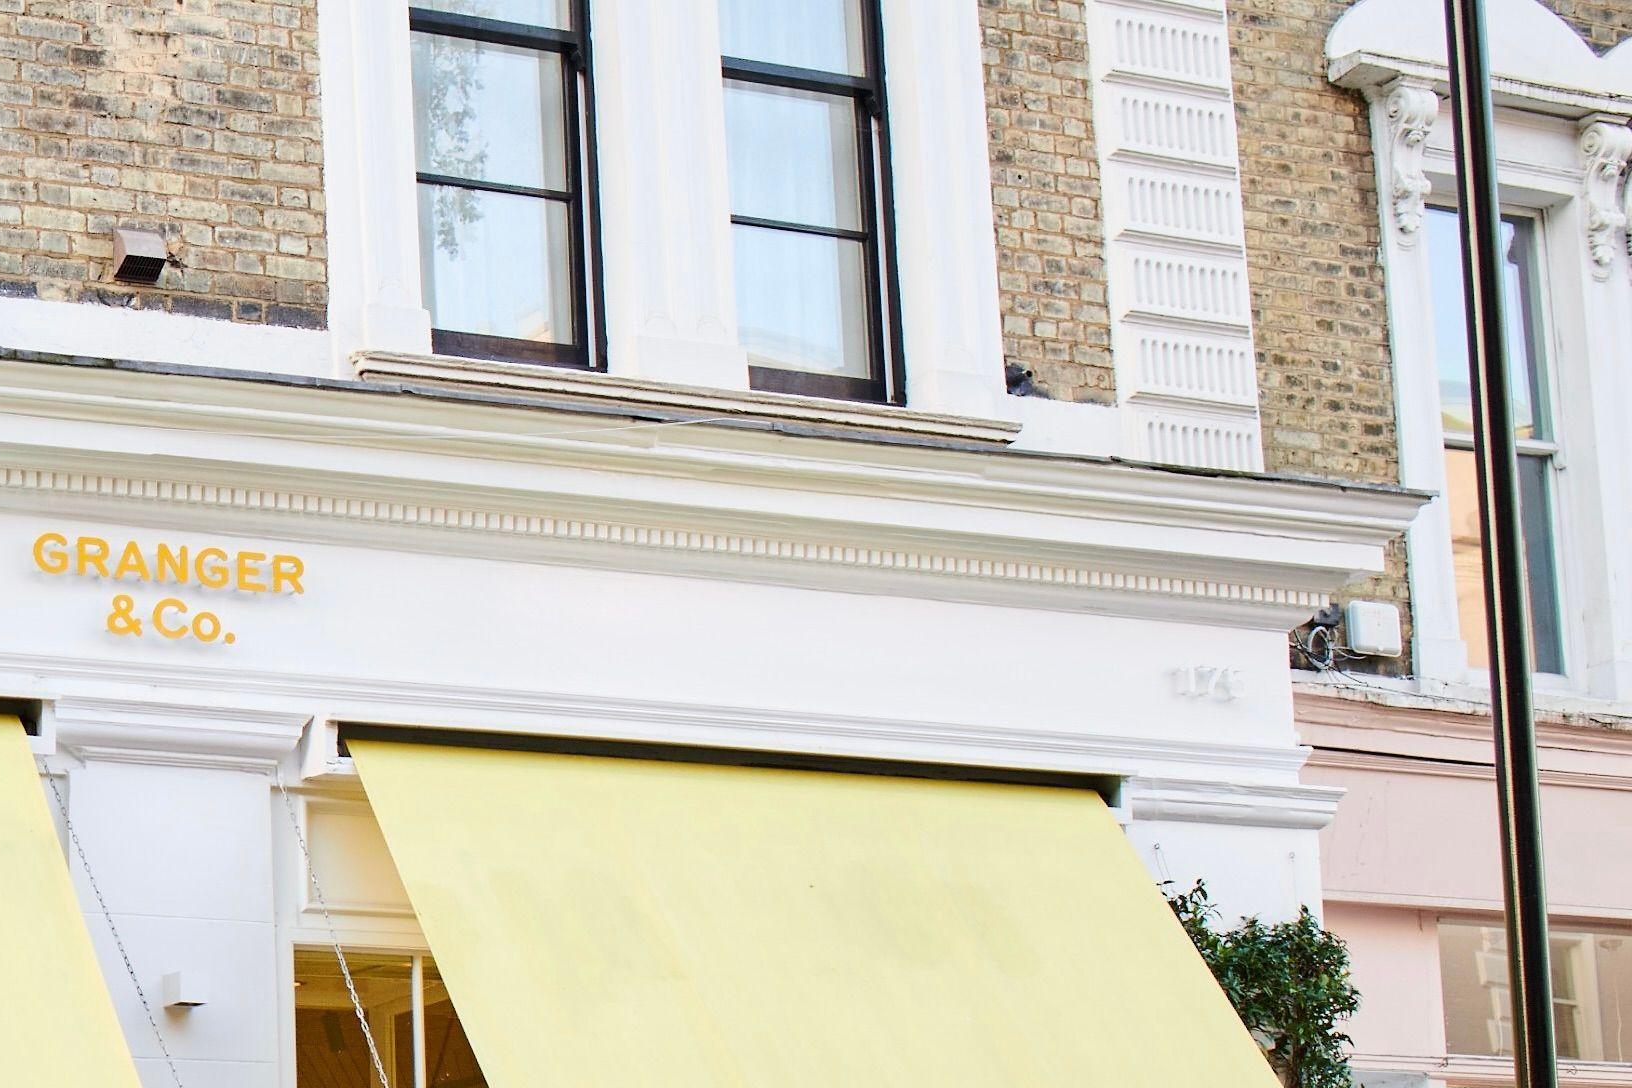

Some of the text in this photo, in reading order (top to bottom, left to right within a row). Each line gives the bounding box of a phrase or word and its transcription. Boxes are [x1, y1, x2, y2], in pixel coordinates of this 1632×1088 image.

[32, 532, 305, 594] GRANGER
[106, 594, 236, 645] & Co.
